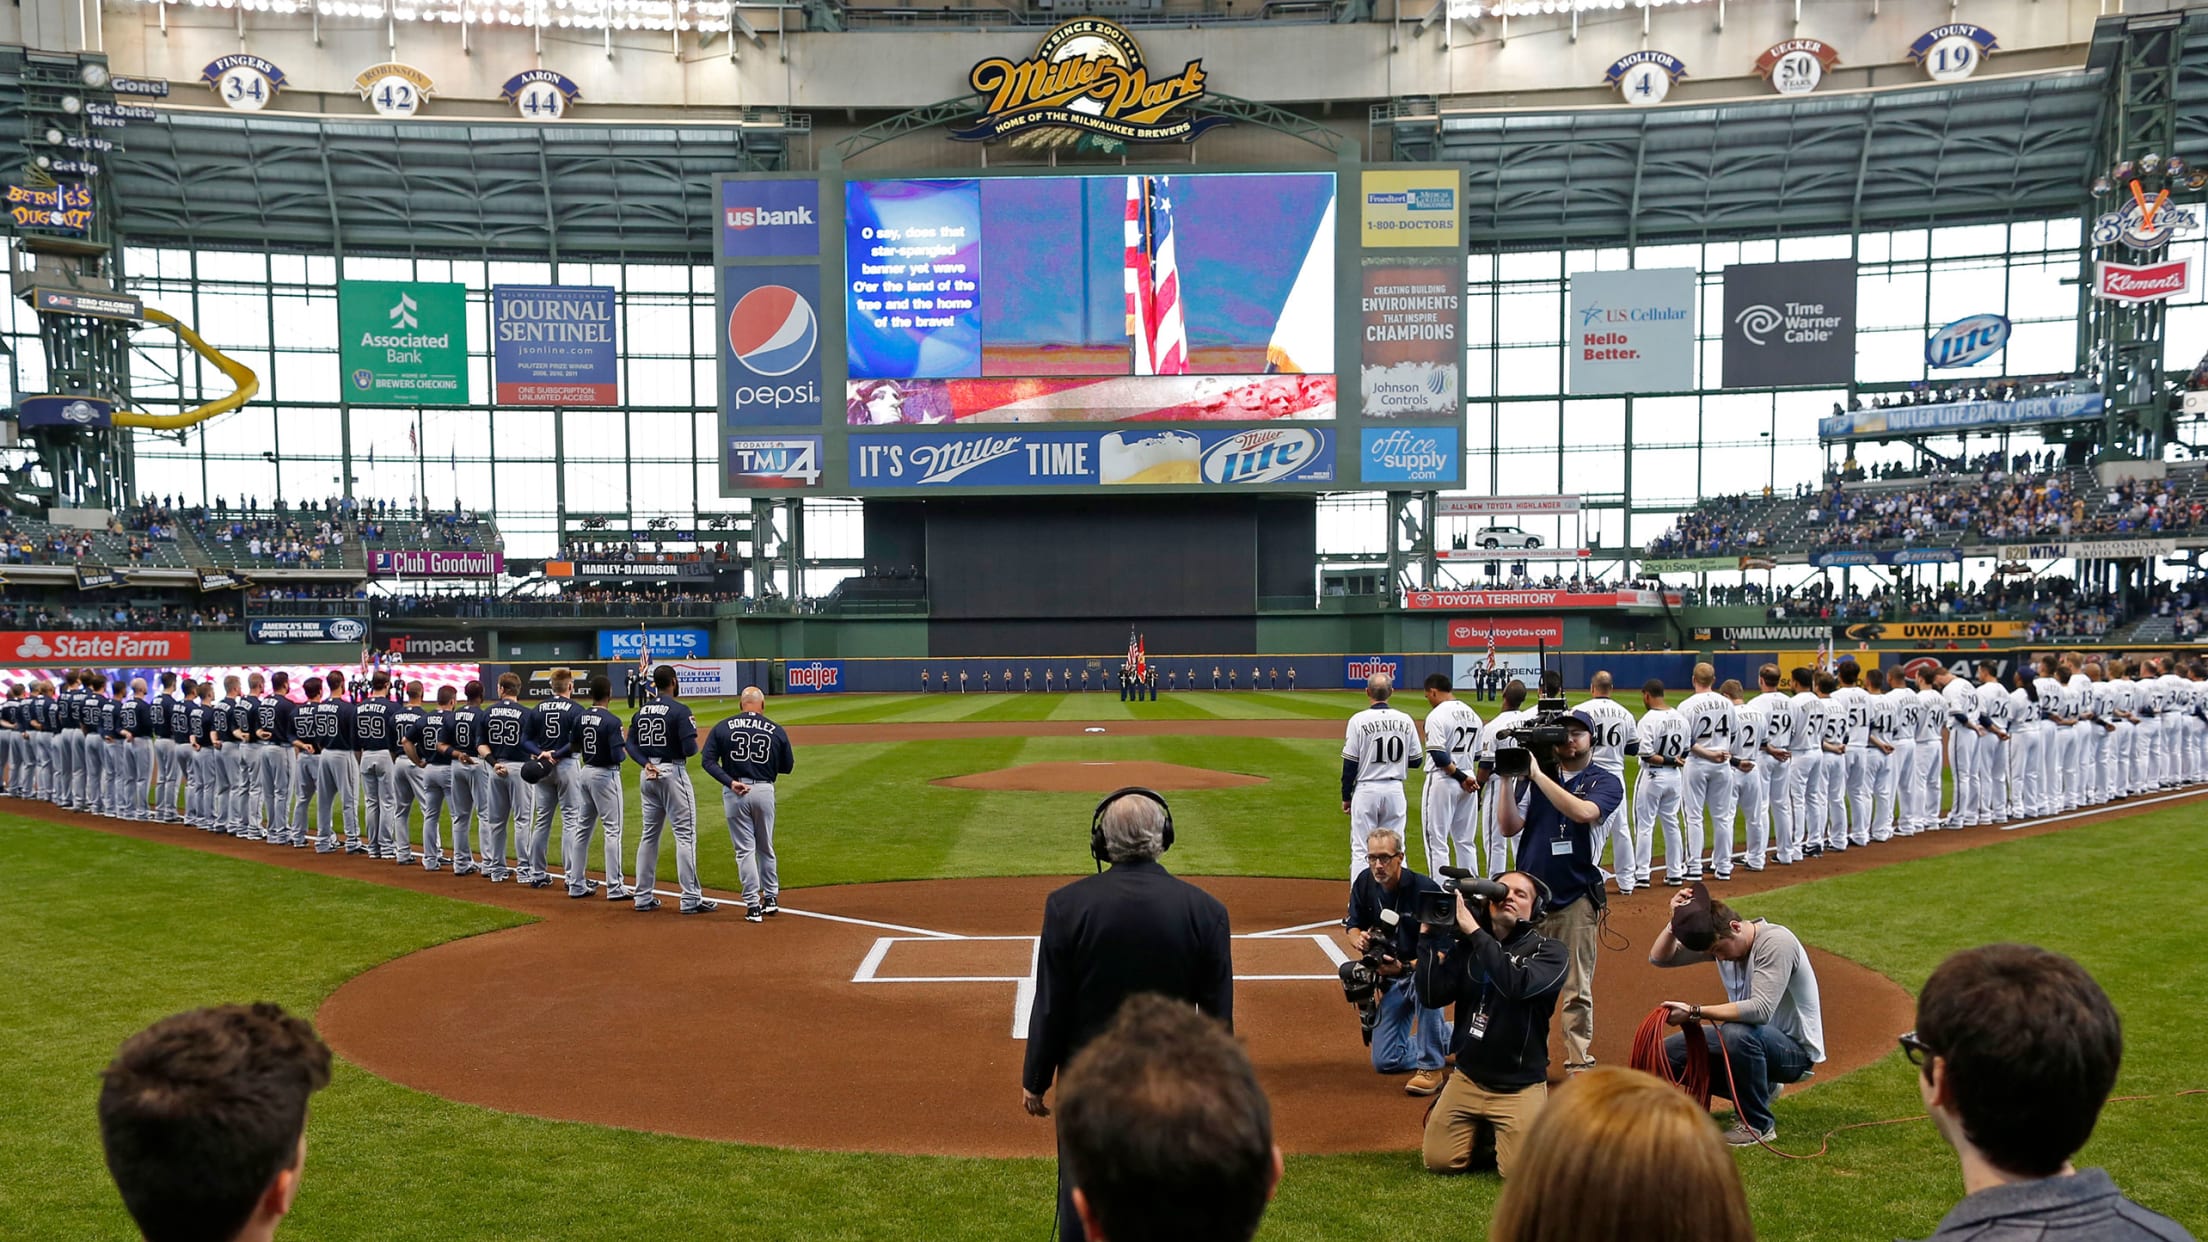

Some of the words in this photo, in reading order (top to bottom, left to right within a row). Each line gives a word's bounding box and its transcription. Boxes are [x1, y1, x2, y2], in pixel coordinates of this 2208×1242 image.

[1051, 22, 1092, 45] SINCE
[1095, 23, 1125, 43] 2001
[1929, 25, 1978, 40] YOUNT
[1770, 39, 1821, 57] UECKER
[215, 56, 273, 74] FINGERS
[1617, 52, 1674, 71] MOLITOR
[1934, 45, 1973, 73] 19
[364, 64, 424, 83] ROBINSON
[1782, 57, 1812, 79] 50
[520, 70, 561, 85] AARON
[1635, 73, 1653, 97] 4
[111, 78, 168, 94] Gone!
[227, 76, 264, 103] 34
[972, 53, 1118, 121] Miller
[1088, 60, 1206, 124] Park
[377, 85, 414, 111] 42
[523, 91, 559, 116] 44
[85, 103, 111, 115] Get
[114, 105, 156, 118] Outta
[91, 115, 126, 127] Here
[995, 115, 1027, 134] HOME
[1028, 112, 1042, 123] OF
[1045, 112, 1068, 122] THE
[1070, 114, 1136, 137] MILWAUKEE
[1137, 122, 1192, 138] BREWERS
[66, 137, 91, 148] Get
[93, 139, 113, 151] Up
[52, 160, 77, 172] Get
[79, 163, 99, 174] Up
[7, 183, 91, 210] BERNIE'S
[11, 206, 93, 229] DUGOUT
[1367, 220, 1454, 230] 1-800-DOCTORS
[861, 227, 874, 239] O
[876, 229, 902, 241] say,
[905, 227, 936, 238] does
[940, 226, 965, 238] that
[2092, 210, 2199, 246] Brewers
[871, 244, 956, 258] star-spangled
[862, 263, 905, 275] banner
[910, 263, 929, 277] yet
[933, 263, 966, 273] wave
[882, 281, 903, 292] the
[907, 280, 934, 292] land
[937, 280, 951, 291] of
[954, 280, 975, 291] the
[1373, 286, 1410, 295] CREATING
[1411, 285, 1447, 294] BUILDING
[2106, 272, 2184, 292] Klement's
[76, 297, 98, 306] ZERO
[98, 299, 136, 310] CALORIES
[499, 299, 611, 321] JOURNAL
[856, 299, 882, 310] free
[885, 298, 909, 310] and
[912, 298, 933, 309] the
[937, 298, 972, 309] home
[1362, 295, 1458, 311] ENVIRONMENTS
[1784, 302, 1824, 315] Time
[874, 316, 888, 328] of
[891, 316, 912, 328] the
[1383, 314, 1403, 323] THAT
[1405, 313, 1438, 323] INSPIRE
[1630, 307, 1687, 321] Cellular
[1784, 316, 1841, 329] Warner
[361, 332, 449, 348] Associated
[499, 322, 612, 342] SENTINEL
[1366, 324, 1455, 341] CHAMPIONS
[1584, 333, 1627, 345] Hello
[1784, 329, 1828, 343] Cable
[518, 345, 593, 356] jsonline.com
[1939, 323, 2000, 366] Lite
[387, 348, 422, 363] Bank
[1584, 348, 1640, 360] Better.
[375, 378, 415, 389] BREWERS
[416, 379, 457, 389] CHECKING
[518, 386, 535, 394] ONE
[1372, 381, 1420, 394] Johnson
[735, 380, 814, 410] pepsi
[1381, 394, 1429, 405] Controls
[1969, 402, 2012, 421] PARTY
[2016, 398, 2052, 417] DECK
[1234, 431, 1284, 452] Miller
[1371, 430, 1438, 462] office
[859, 445, 904, 478] IT'S
[910, 436, 1023, 484] Miller
[1221, 441, 1304, 484] Lite
[1384, 450, 1447, 471] supply
[1408, 471, 1436, 480] .com
[2005, 546, 2027, 559] 620
[2029, 545, 2067, 559] WTMJ
[2074, 548, 2108, 558] RADIO
[2081, 540, 2161, 551] WISCONSIN'S
[393, 553, 425, 573] Club
[431, 553, 494, 573] Goodwill
[582, 564, 678, 575] HARLEY-DAVIDSON
[1673, 562, 1697, 571] Save
[1436, 594, 1484, 605] TOYOTA
[1486, 593, 1556, 604] TERRITORY
[258, 630, 287, 638] SPORTS
[288, 630, 325, 638] NETWORK
[337, 624, 355, 632] FOX
[1471, 627, 1557, 639] buytoyota.com
[1903, 624, 1993, 637] UWM.EDU
[405, 634, 475, 656] impact
[612, 634, 697, 648] KOHL'S
[789, 662, 838, 690] meijer
[1348, 657, 1397, 680] meijer
[695, 686, 721, 694] DREAMS
[539, 701, 572, 712] FREEMAN
[639, 704, 670, 716] HEYWARD
[1991, 700, 2008, 719] 26
[2042, 695, 2060, 712] 22
[455, 712, 476, 722] UPTON
[489, 707, 522, 720] JOHNSON
[581, 714, 603, 727] UPTON
[1848, 707, 1867, 728] 51
[315, 714, 338, 737] 58
[357, 715, 386, 738] 59
[488, 719, 521, 746] 23
[545, 712, 561, 739] 5
[637, 717, 667, 747] 22
[727, 718, 777, 734] GONZALEZ
[1361, 720, 1411, 736] ROENICKE
[1697, 714, 1730, 739] 24
[1768, 713, 1792, 736] 59
[1807, 714, 1824, 736] 57
[456, 722, 470, 747] 8
[582, 726, 597, 754] 2
[1451, 726, 1478, 753] 27
[1596, 722, 1622, 747] 16
[1742, 725, 1755, 748] 2
[730, 731, 772, 764] 33
[1370, 735, 1404, 764] 10
[1658, 733, 1682, 758] 18
